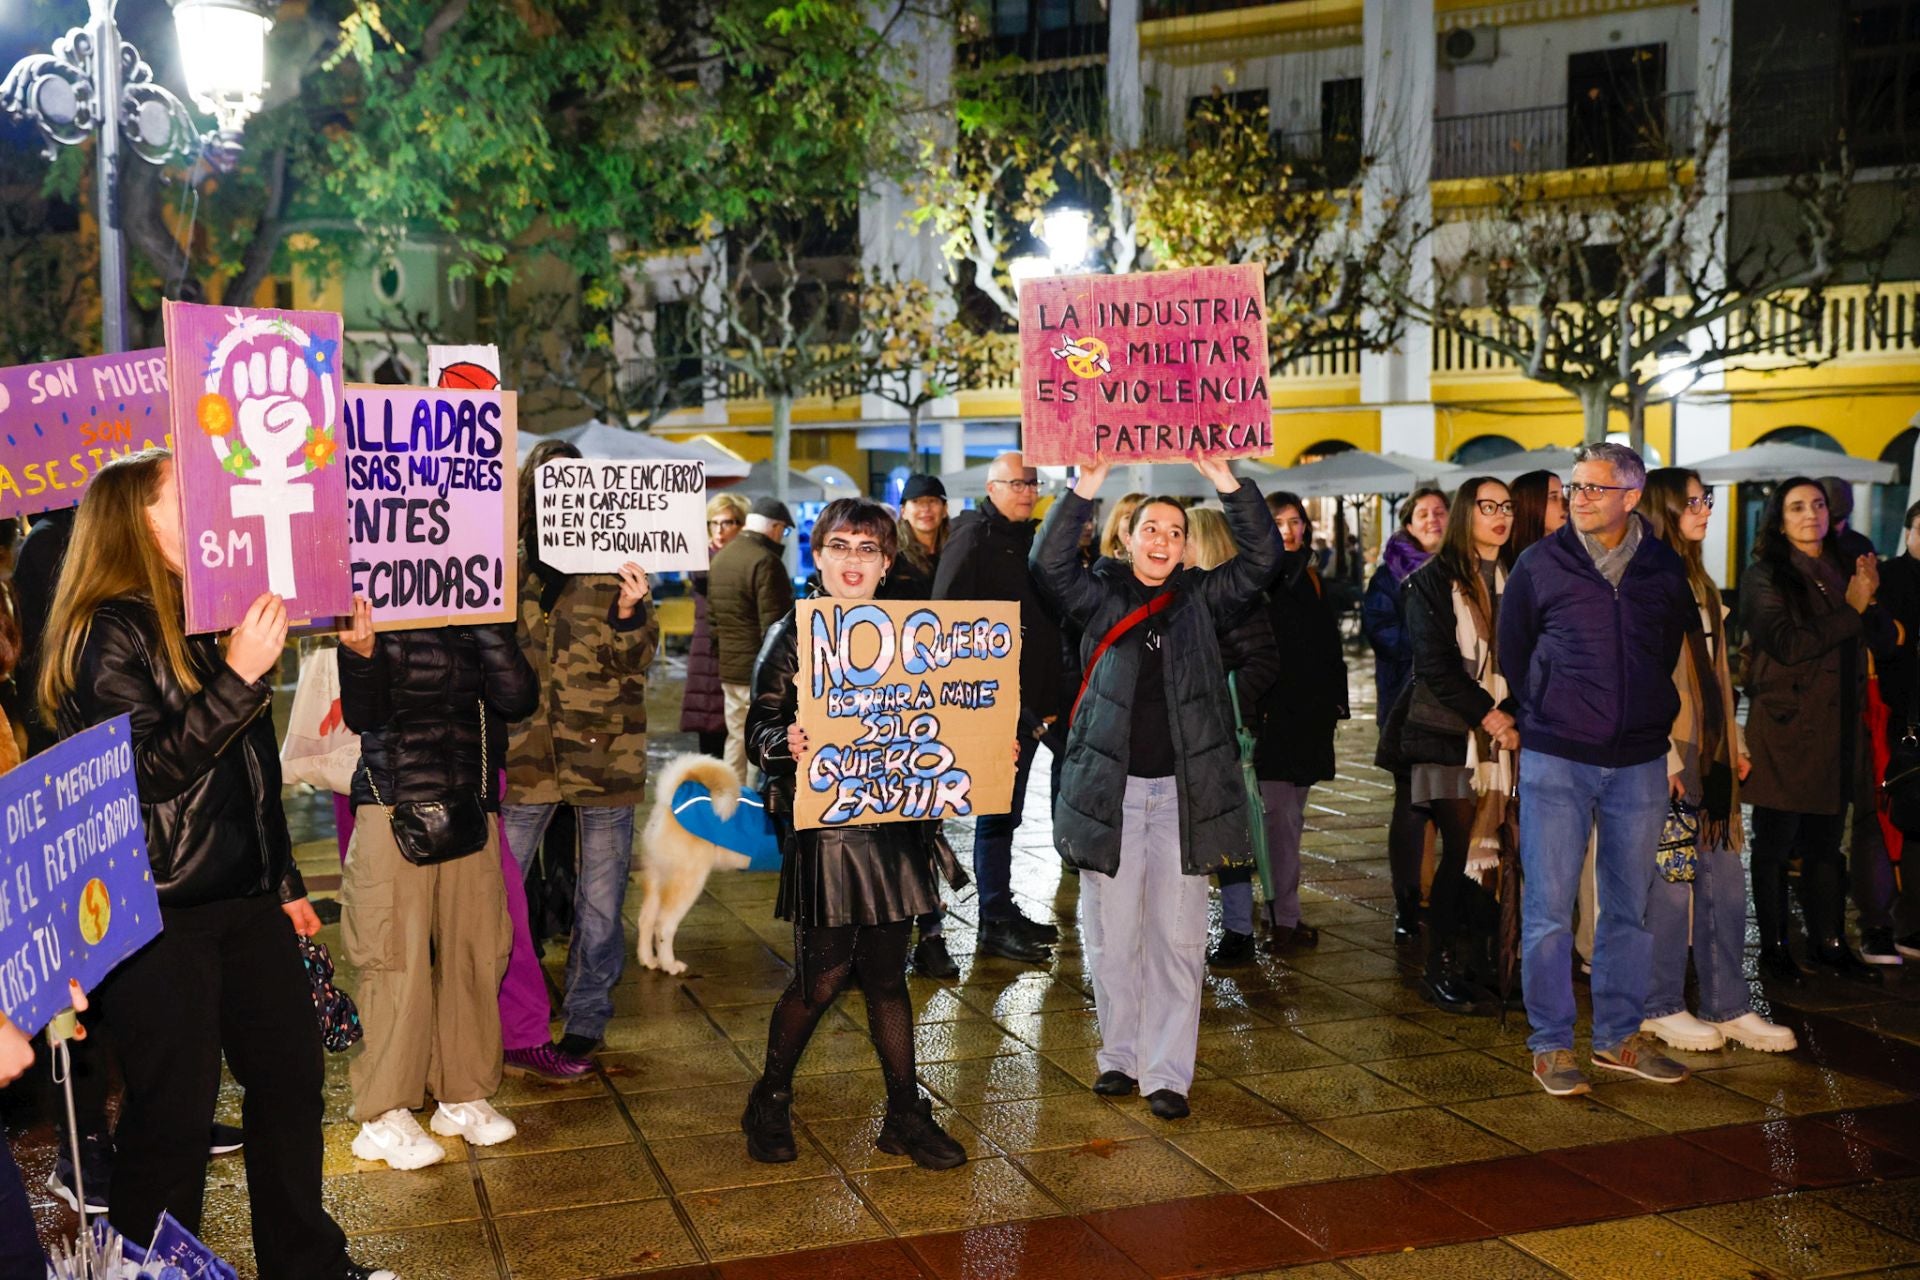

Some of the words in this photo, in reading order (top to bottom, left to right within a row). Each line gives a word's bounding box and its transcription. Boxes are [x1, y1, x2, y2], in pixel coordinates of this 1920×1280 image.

[1038, 302, 1079, 330] LA
[1098, 297, 1261, 327] INDUSTRIA
[1127, 335, 1250, 366] MILITAR
[28, 362, 78, 404] SON
[93, 357, 169, 401] MUER
[1037, 379, 1077, 402] ES
[1100, 376, 1267, 404] VIOLENCIA
[79, 418, 132, 446] SON
[1094, 422, 1272, 452] PATRIARCAL
[408, 456, 502, 499] MUJERES
[543, 462, 595, 489] BASTA
[602, 465, 626, 488] DE
[631, 461, 704, 493] ENCIERROS
[543, 496, 556, 510] NI
[565, 495, 585, 509] EN
[590, 493, 668, 511] CARCELES
[543, 514, 556, 528] NI
[562, 513, 584, 528] EN
[590, 512, 626, 529] CIES
[348, 498, 450, 545] NTES
[199, 530, 253, 568] 8M
[543, 532, 559, 547] NI
[564, 532, 586, 548] EN
[591, 531, 688, 554] PSIQUIATRIA
[811, 604, 896, 698] NO
[901, 608, 1012, 674] QUIERO
[827, 683, 912, 718] BORRAR
[914, 680, 935, 709] A
[941, 679, 999, 710] NADIE
[853, 712, 940, 746] SOLO
[808, 742, 955, 792] QUIERO
[7, 789, 46, 845] DICE
[56, 741, 131, 811] MERCURIO
[819, 768, 972, 824] EXISTIR
[16, 861, 38, 914] EL
[0, 942, 37, 1016] ERES
[33, 912, 61, 982] TÚ
